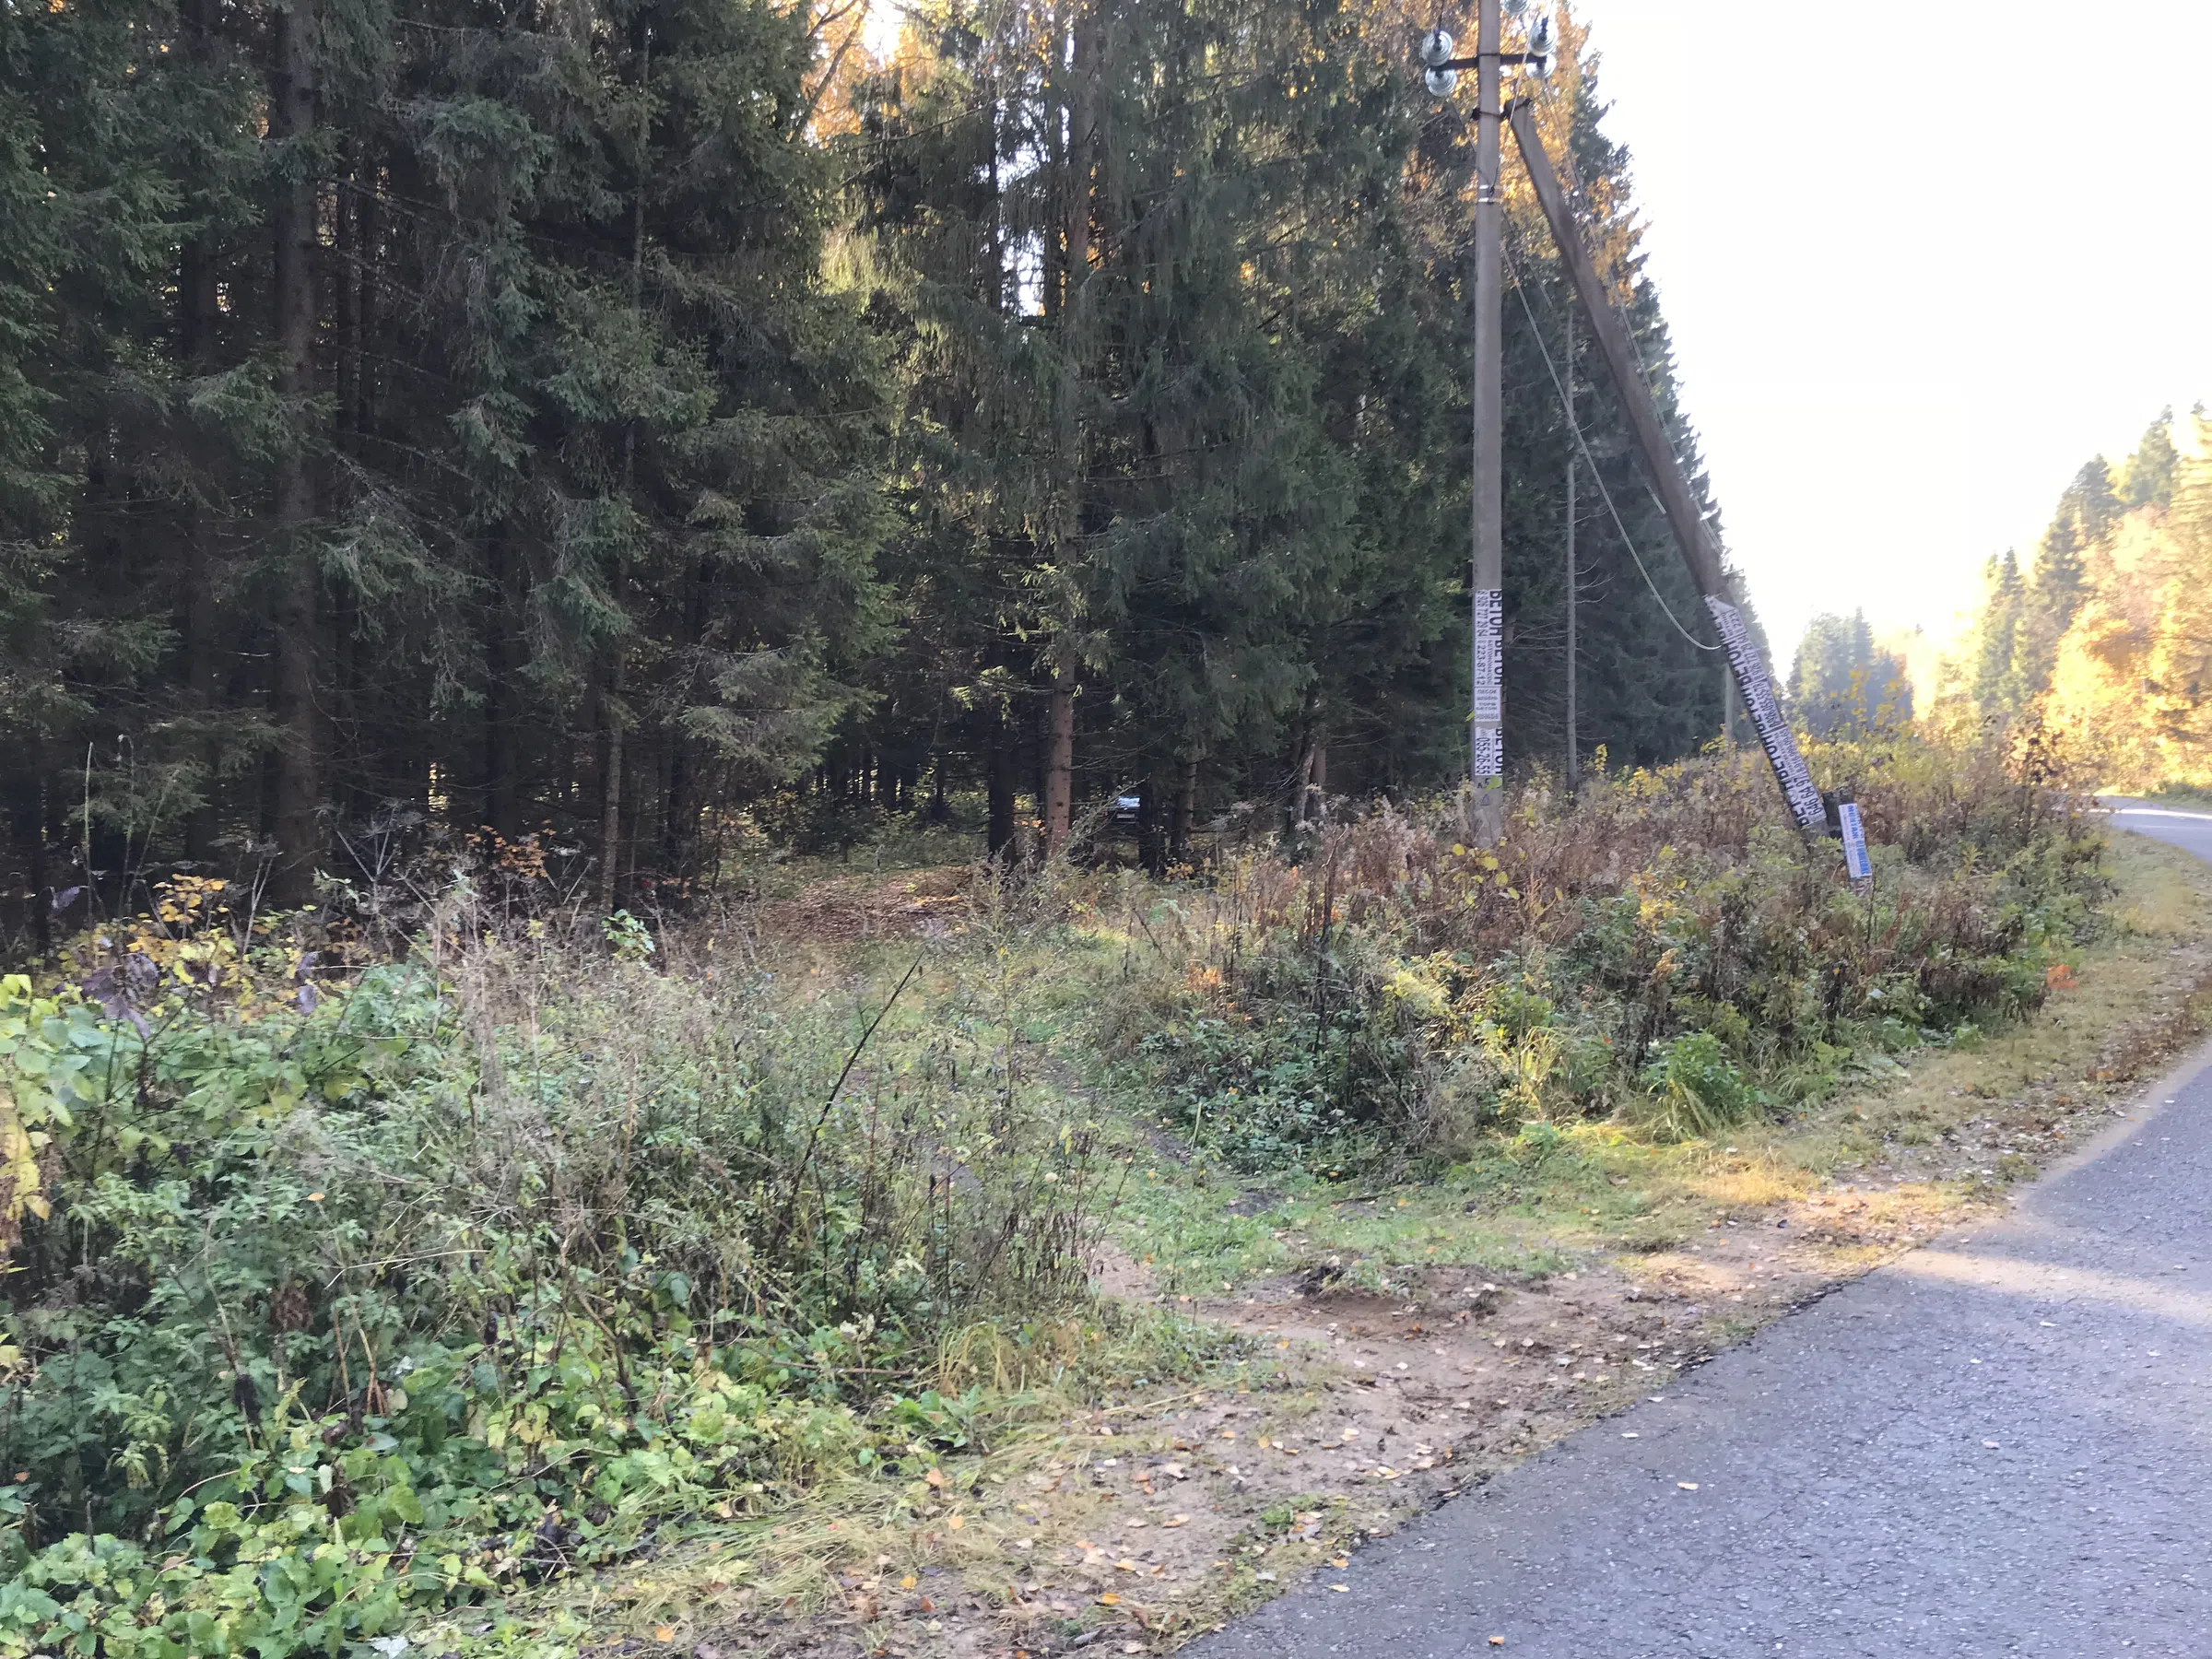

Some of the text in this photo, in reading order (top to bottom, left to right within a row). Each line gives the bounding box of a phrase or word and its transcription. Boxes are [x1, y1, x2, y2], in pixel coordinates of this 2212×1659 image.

[1489, 590, 1502, 636] БЕТОН
[1477, 645, 1487, 686] 223-87-12
[1494, 640, 1503, 686] БЕТОН
[1722, 640, 1752, 687] БЕТОН
[1477, 737, 1490, 774] 055-26-55
[1495, 728, 1503, 774] БЕТОН
[1761, 735, 1788, 780] БЕТОН
[1793, 772, 1823, 816] 646 64 97
